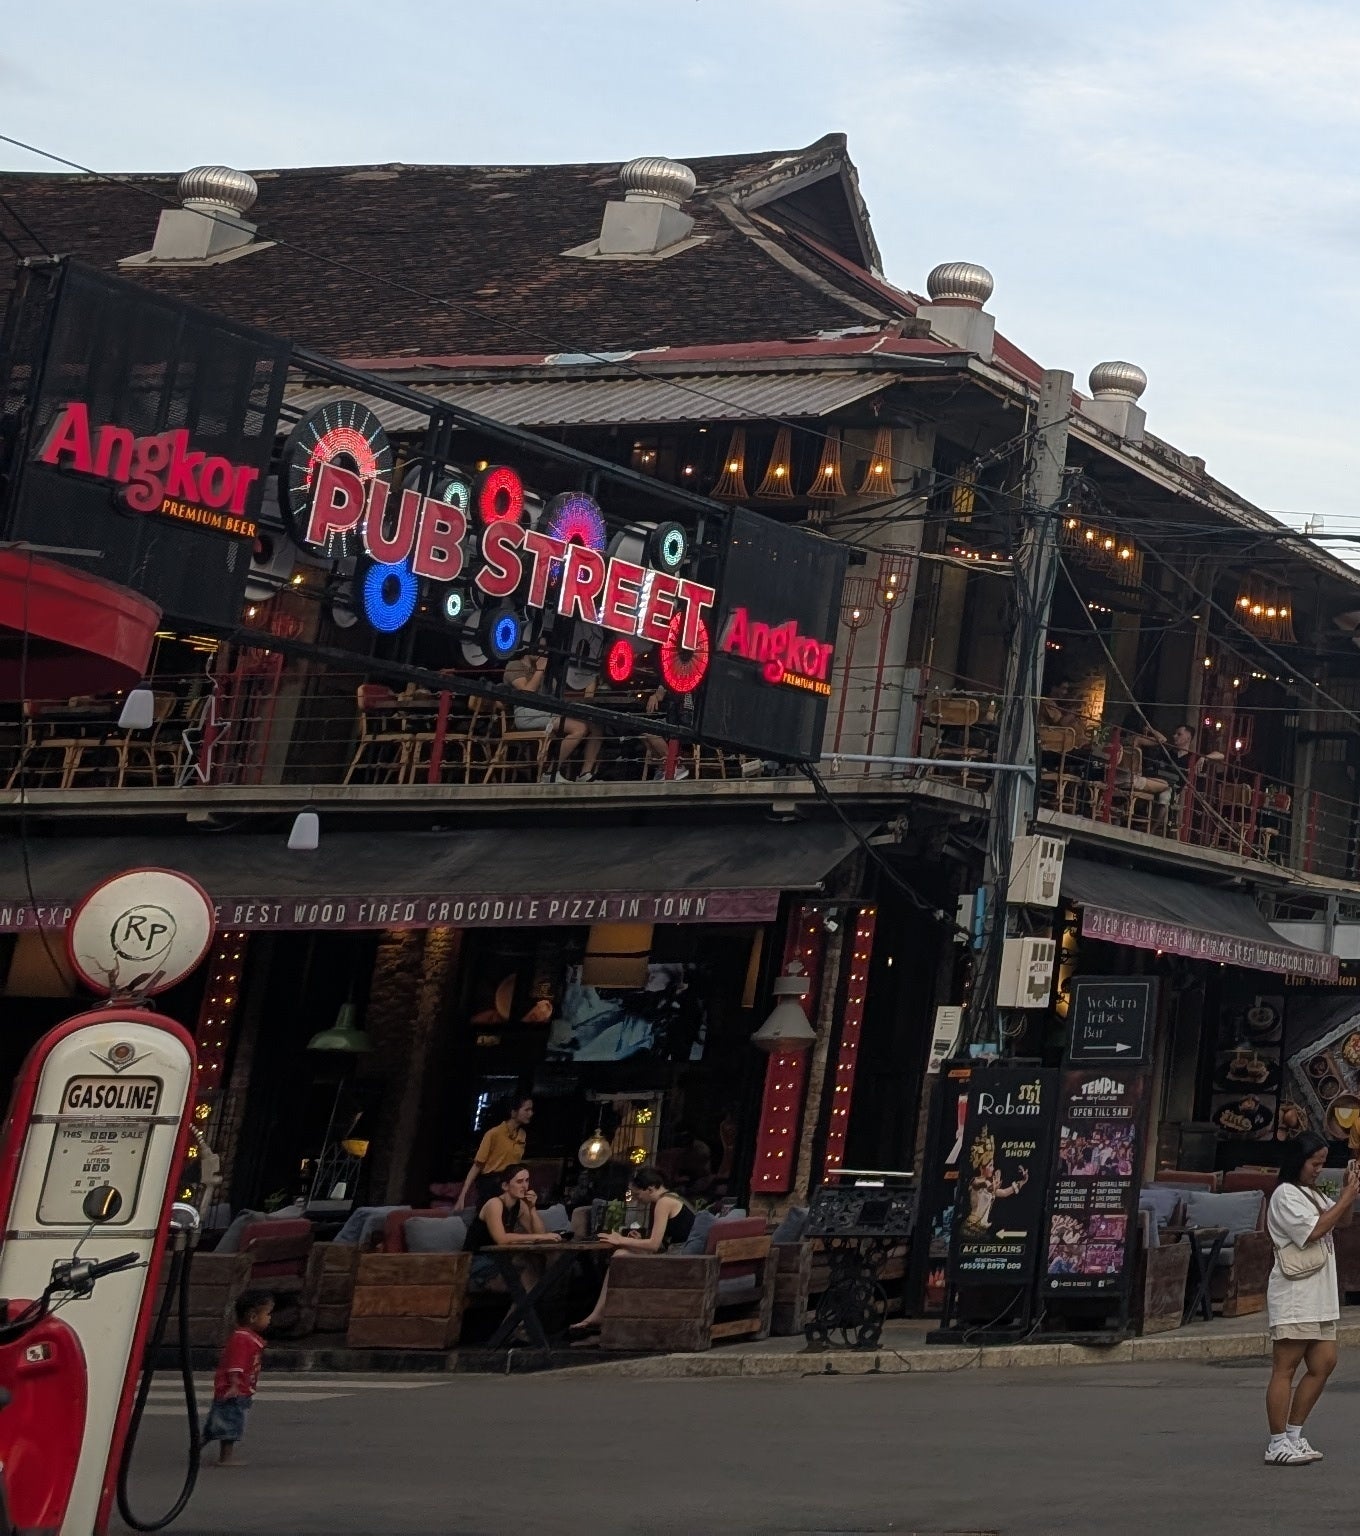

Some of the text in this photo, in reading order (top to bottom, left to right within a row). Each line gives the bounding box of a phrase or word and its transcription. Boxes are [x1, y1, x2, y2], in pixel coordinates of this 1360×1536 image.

[38, 401, 260, 515] Angkor
[161, 499, 257, 538] PREMIUM BEER
[306, 463, 716, 651] PUB STREET
[717, 607, 834, 683] Angkor
[783, 672, 832, 696] PREMIUM BEER
[233, 904, 283, 924] BEST
[294, 903, 347, 924] WOOD
[358, 902, 417, 923] FIRED
[427, 900, 540, 922] CROCODILE
[548, 899, 608, 920] PIZZA
[618, 898, 641, 919] IN
[653, 897, 707, 918] TOWN
[67, 1084, 157, 1109] GASOLINE
[1081, 1077, 1125, 1095] TEMPLE
[978, 1092, 1041, 1115] Robam
[1073, 1107, 1093, 1117] OPEN
[1094, 1107, 1111, 1117] TILL
[62, 1130, 83, 1139] THIS
[120, 1131, 145, 1139] SALE
[1001, 1140, 1036, 1149] APSARA
[1004, 1149, 1032, 1158] SHOW
[962, 1245, 1022, 1254] A/C UPSTAIRS
